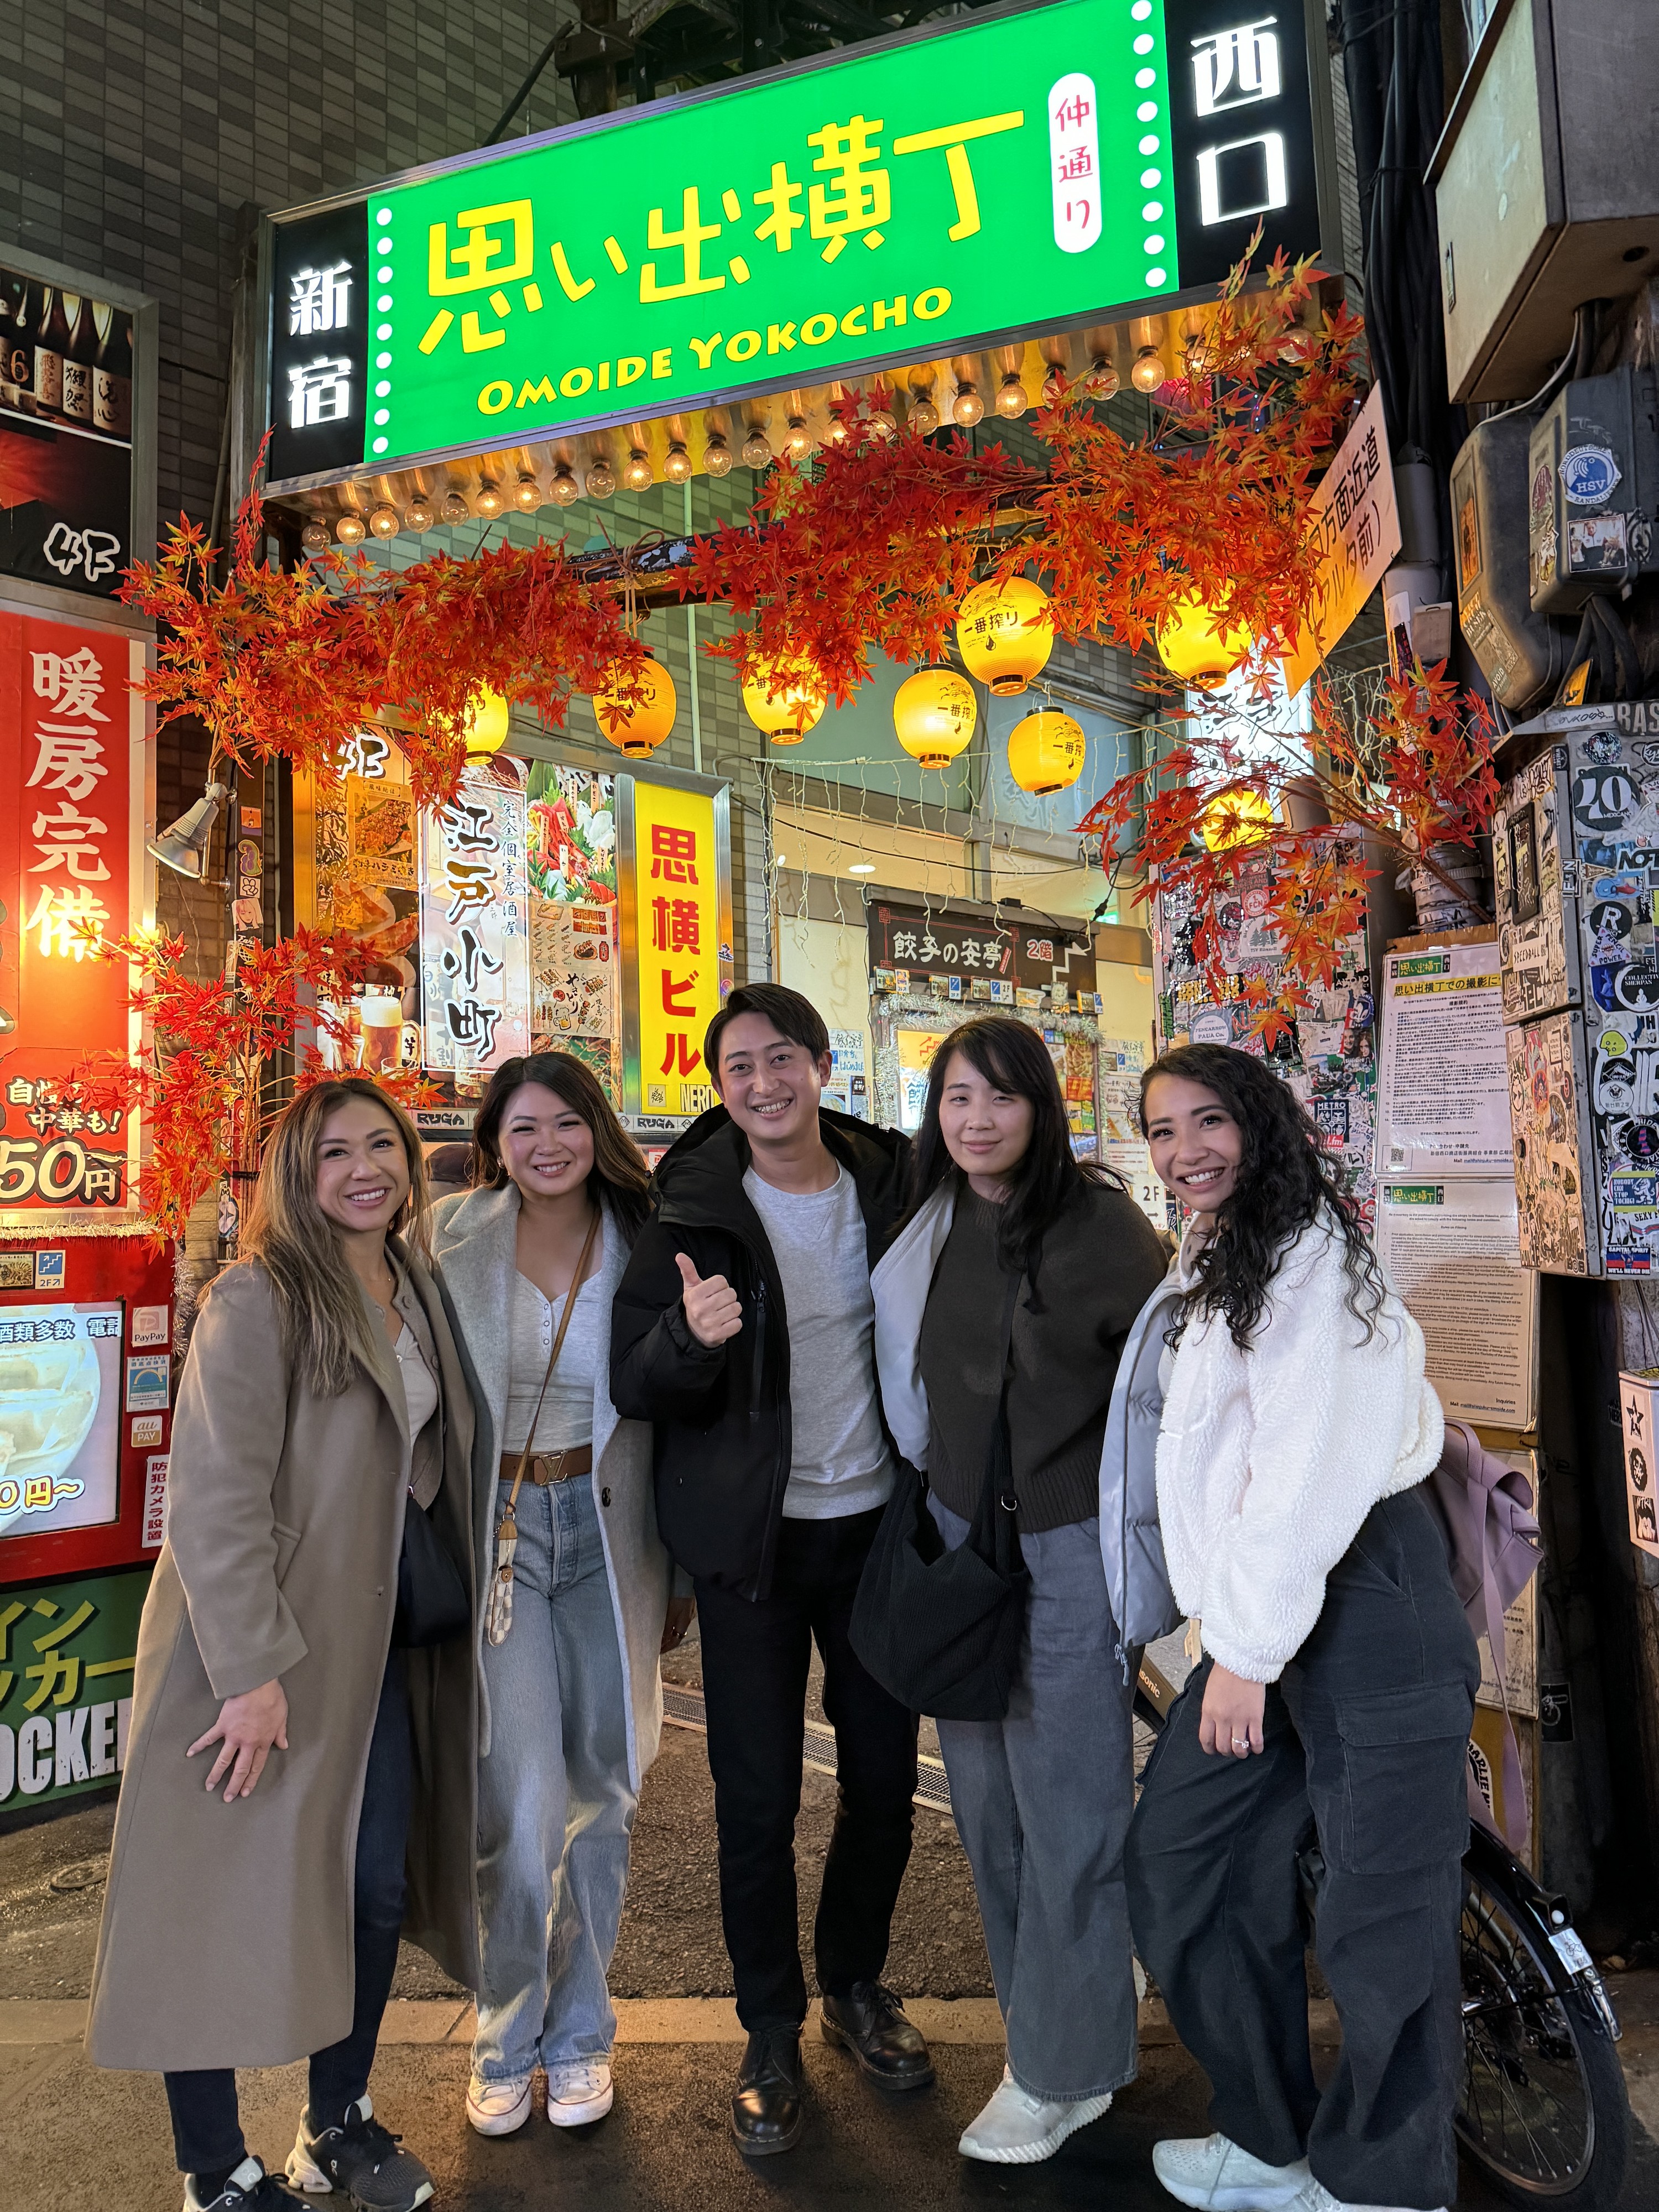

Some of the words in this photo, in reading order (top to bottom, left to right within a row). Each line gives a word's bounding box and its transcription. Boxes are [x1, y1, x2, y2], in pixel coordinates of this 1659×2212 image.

[1190, 16, 1287, 227] 西口
[1055, 94, 1093, 229] 仲通り
[418, 109, 1026, 356] 思い出横丁
[288, 260, 353, 429] 新宿
[477, 347, 672, 415] OMOIDE
[688, 286, 952, 370] YOKOCHO
[1576, 479, 1605, 493] HSV
[964, 611, 1019, 634] 一番搾り
[1053, 742, 1085, 759] 一番搾
[24, 646, 111, 963] 暖房完備
[500, 801, 518, 937] 完全個室居酒屋
[1249, 900, 1263, 909] FCN
[441, 795, 504, 1063] 江戸小町
[650, 823, 702, 1078] 思横ビル
[893, 931, 1002, 969] 餃子の安亭
[1027, 938, 1053, 962] 2階
[1593, 935, 1604, 958] SUPER
[1605, 933, 1625, 953] PENCIL
[1514, 947, 1541, 964] SPEEDBALL
[1599, 954, 1623, 965] POWER
[1395, 976, 1501, 996] 思い出横丁での撮影に
[1143, 1186, 1160, 1202] 2F
[1635, 1212, 1652, 1222] SEXY
[40, 1279, 51, 1287] 2F
[134, 1333, 166, 1342] PayPay
[137, 1422, 158, 1430] au
[138, 1432, 156, 1442] PAY
[147, 1461, 169, 1542] 防犯カメラ設置
[1139, 1669, 1160, 1698] sonic
